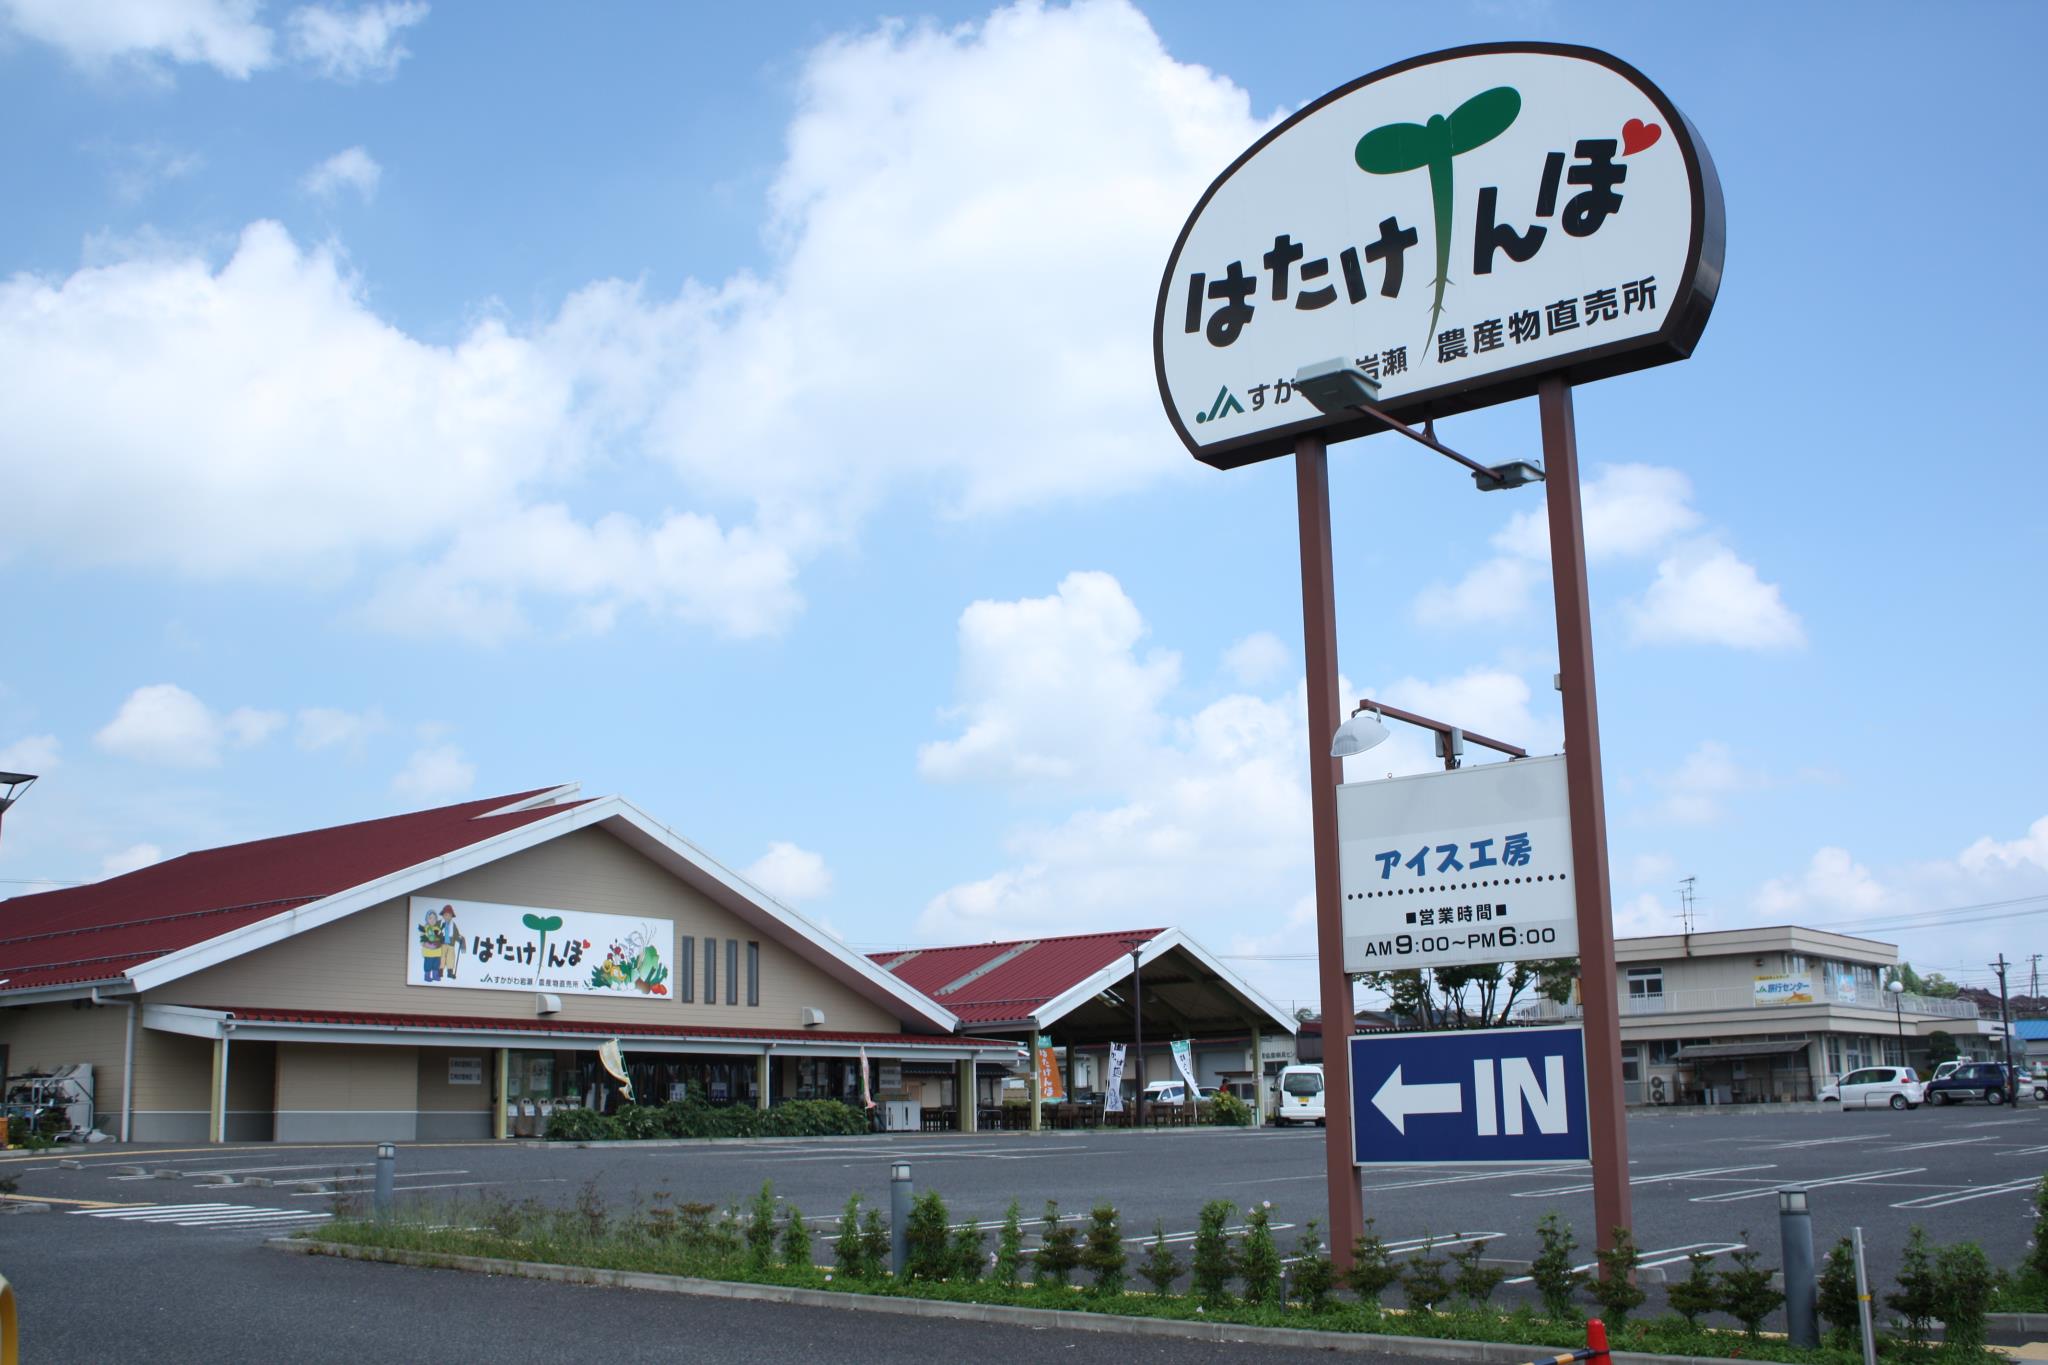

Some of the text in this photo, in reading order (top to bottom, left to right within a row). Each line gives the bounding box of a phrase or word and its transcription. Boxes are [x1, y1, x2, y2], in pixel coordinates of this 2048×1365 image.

[1437, 276, 1657, 364] 農産物直売所
[1375, 832, 1532, 880] アイス工房
[1419, 903, 1493, 926] 営業時間
[1474, 1054, 1568, 1136] IN
